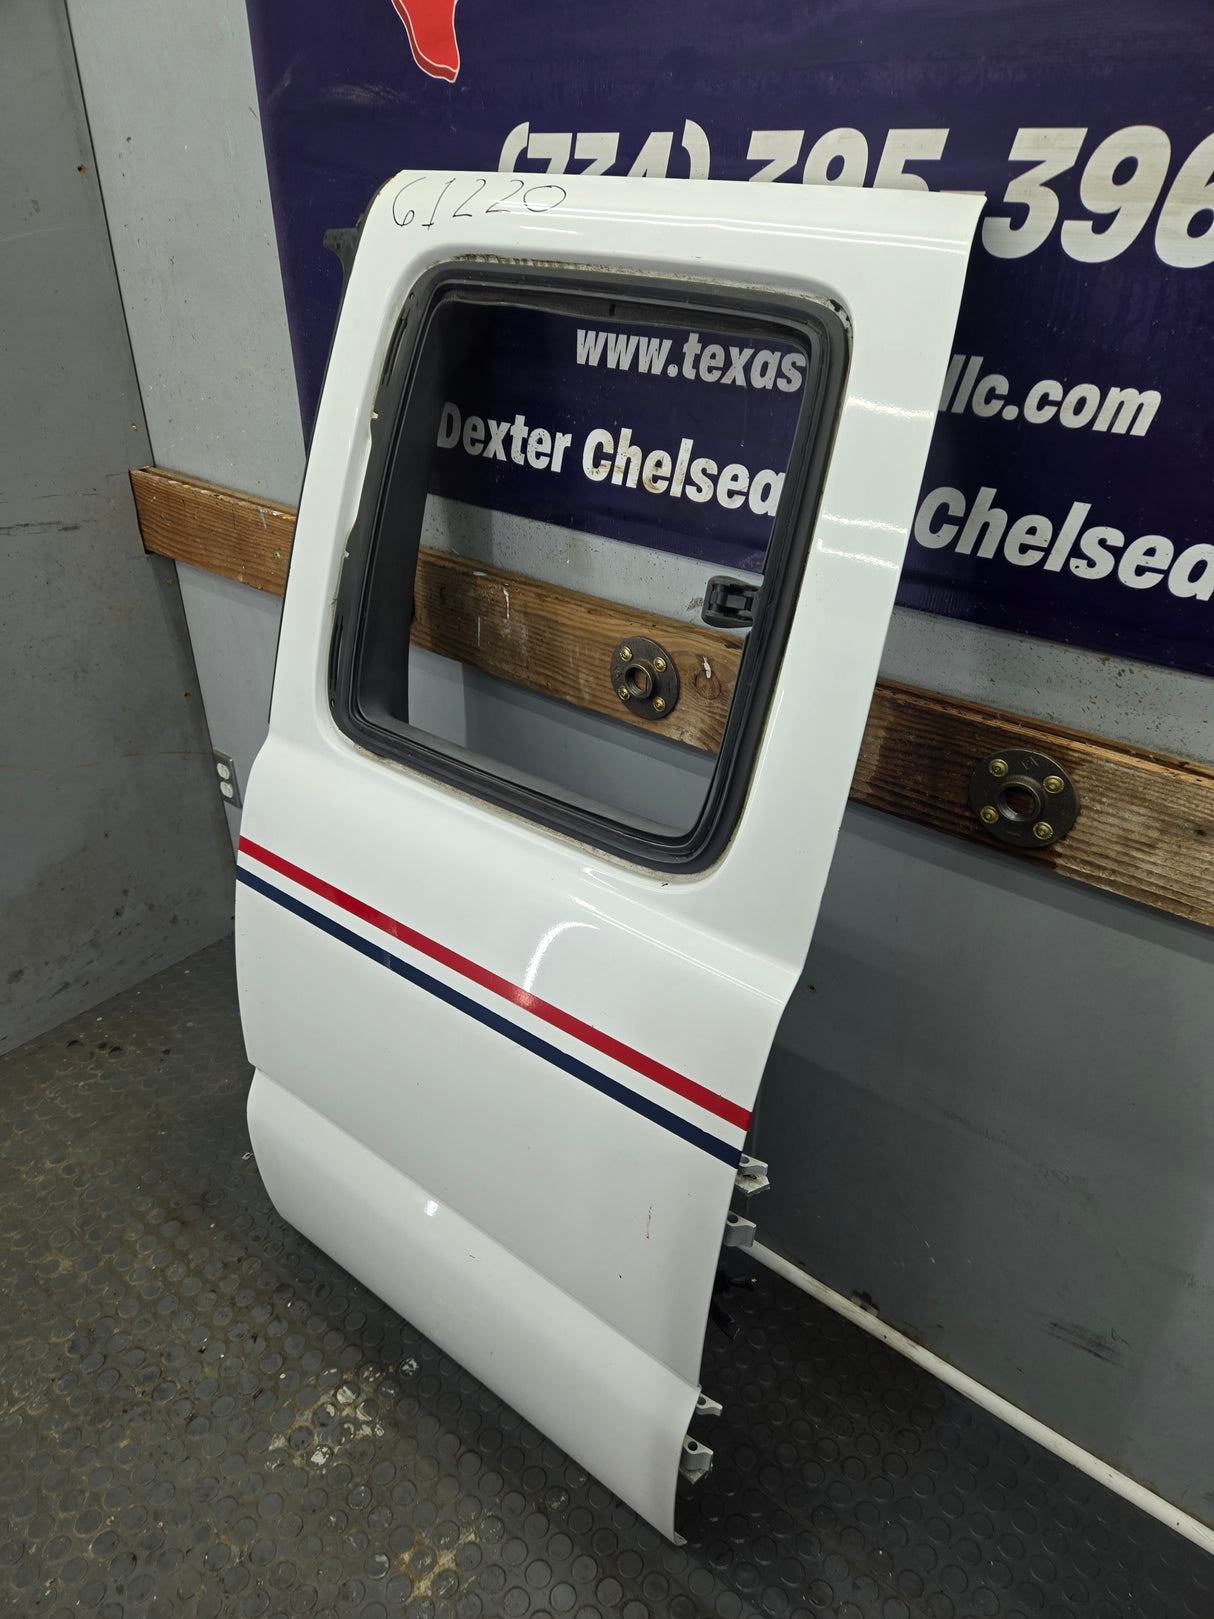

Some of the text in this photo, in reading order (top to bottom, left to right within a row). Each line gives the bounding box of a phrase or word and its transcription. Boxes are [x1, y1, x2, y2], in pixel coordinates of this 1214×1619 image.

[392, 176, 567, 230] 61220
[746, 125, 1214, 268] 95396
[576, 329, 806, 393] www.texas
[436, 402, 1214, 601] Dexter Chelsea Chelsea
